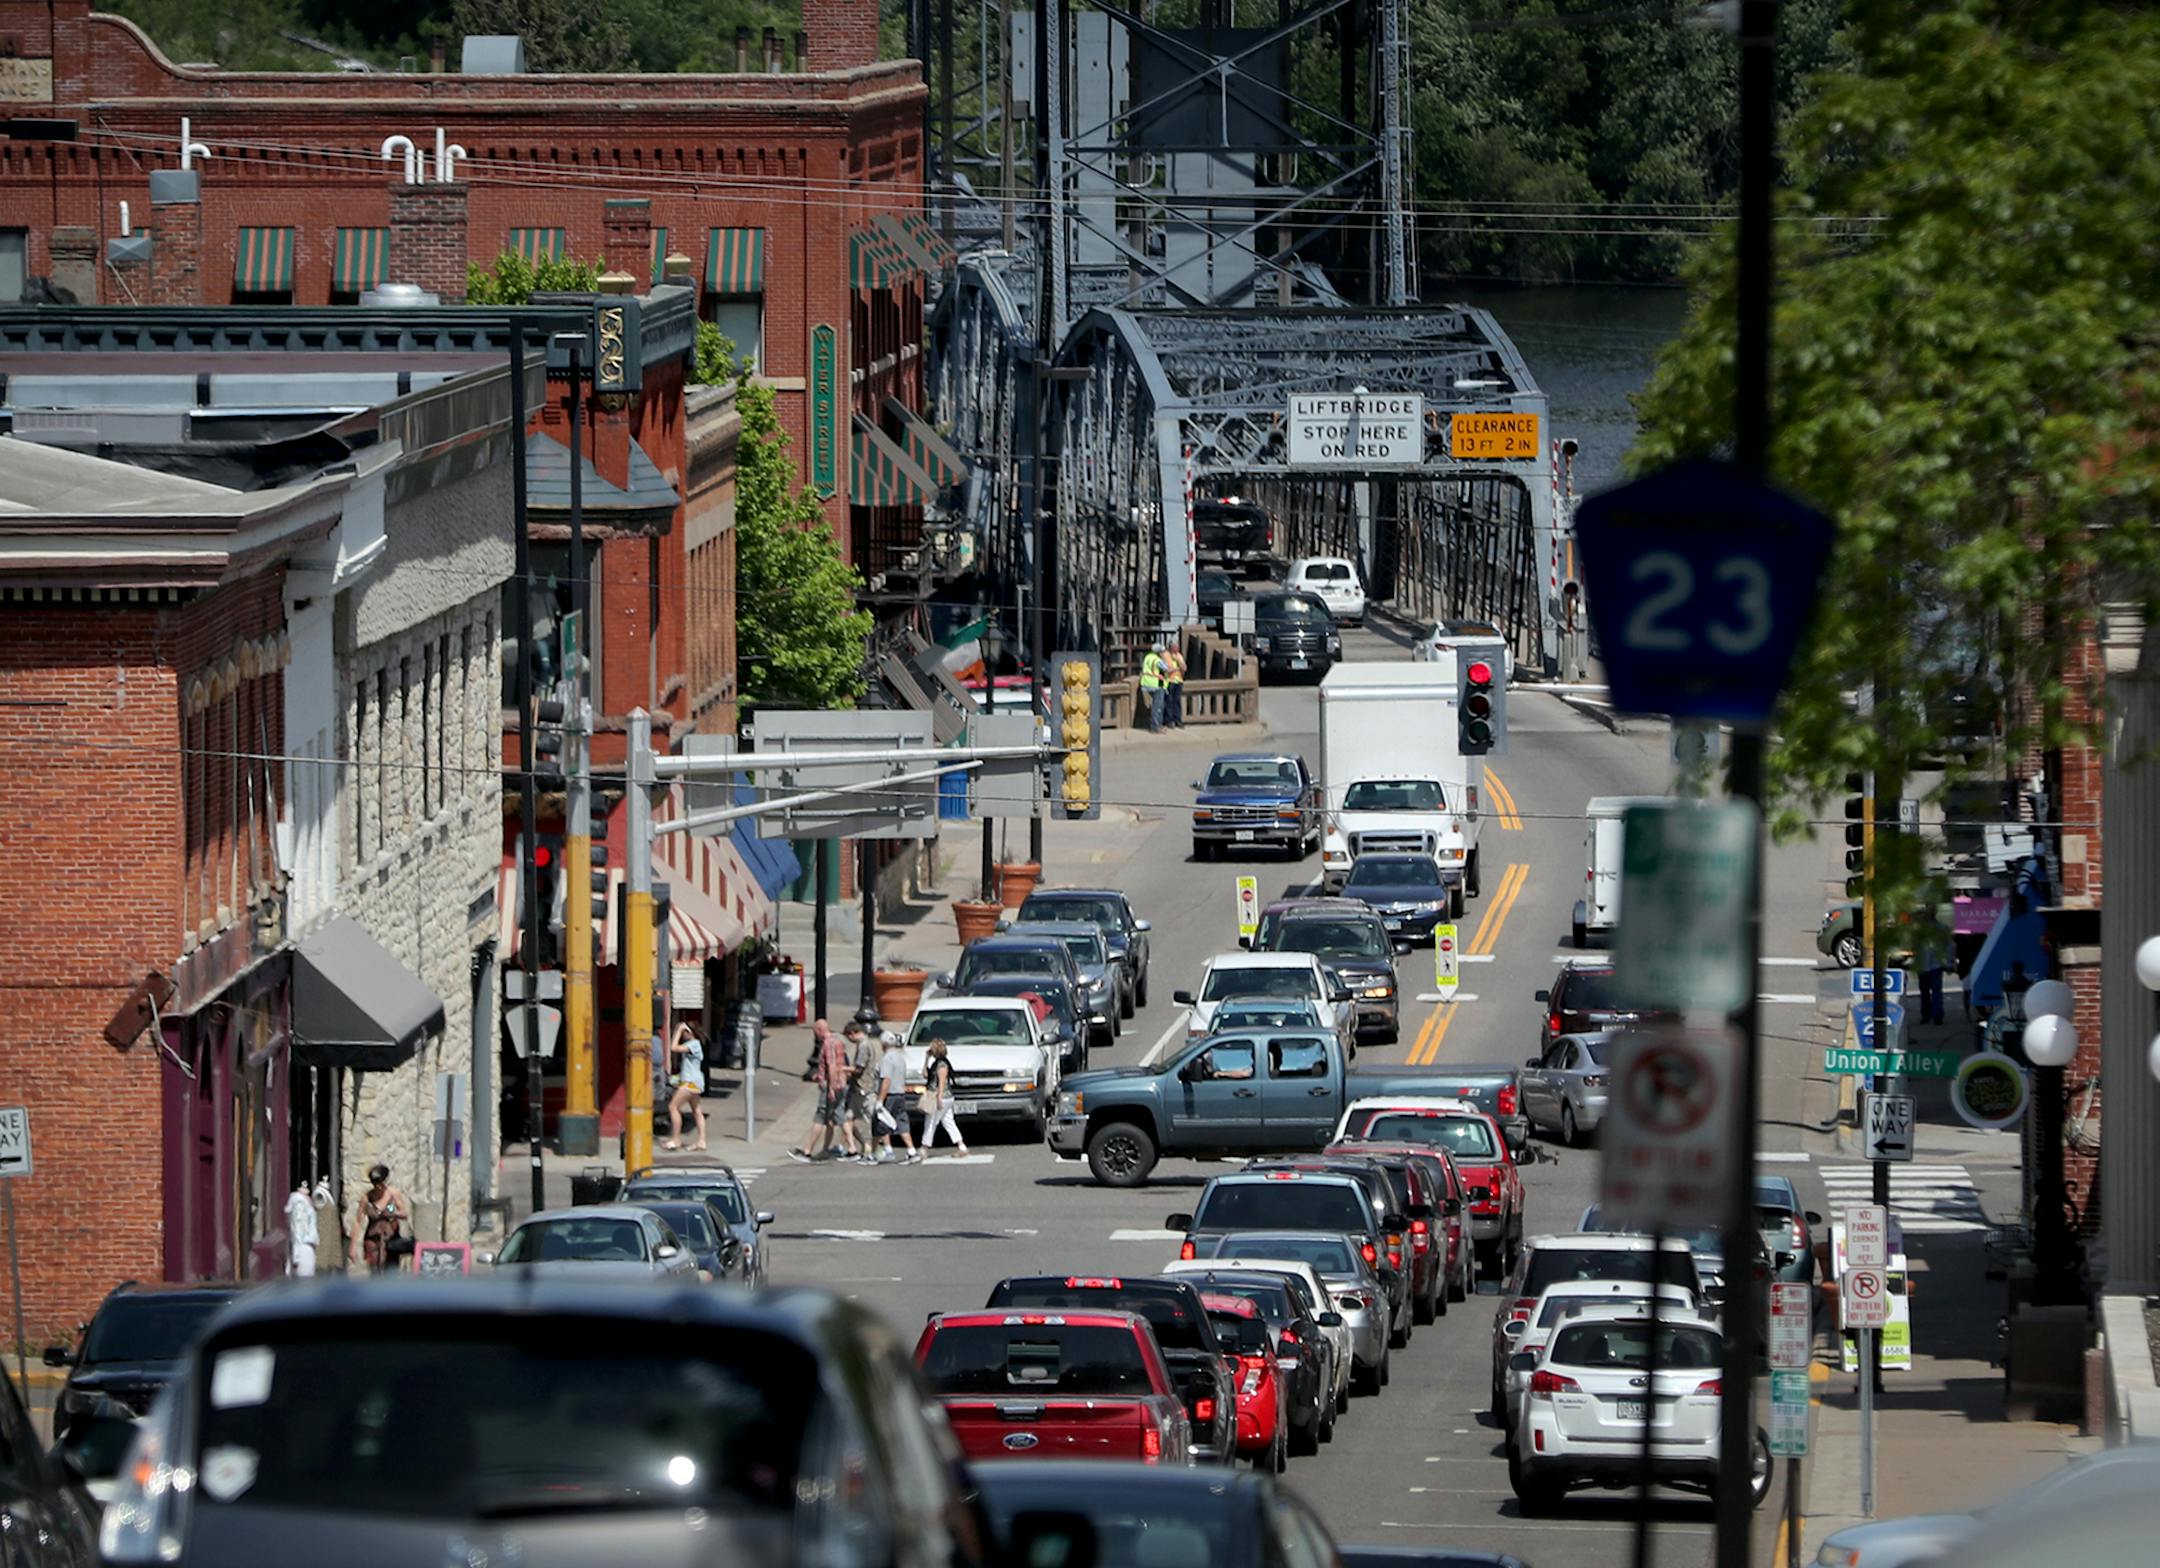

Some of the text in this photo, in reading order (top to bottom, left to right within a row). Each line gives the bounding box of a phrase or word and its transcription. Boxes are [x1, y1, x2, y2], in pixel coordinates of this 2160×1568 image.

[814, 329, 834, 476] WATER STREET
[1298, 400, 1414, 414] LIFTBRIDGE
[1303, 425, 1408, 440] STOP HERE
[1457, 419, 1534, 434] CLEARANCE
[1321, 444, 1390, 457] ON RED
[1460, 437, 1531, 452] 13 FT 2 IN
[1624, 550, 1774, 656] 23
[1824, 1050, 1945, 1074] Union Alley
[1872, 1101, 1909, 1118] ONE
[0, 1112, 20, 1129] NE
[1872, 1120, 1910, 1136] WAY
[0, 1131, 22, 1148] AY
[1858, 1210, 1872, 1220] NO
[1851, 1223, 1881, 1232] PARKING
